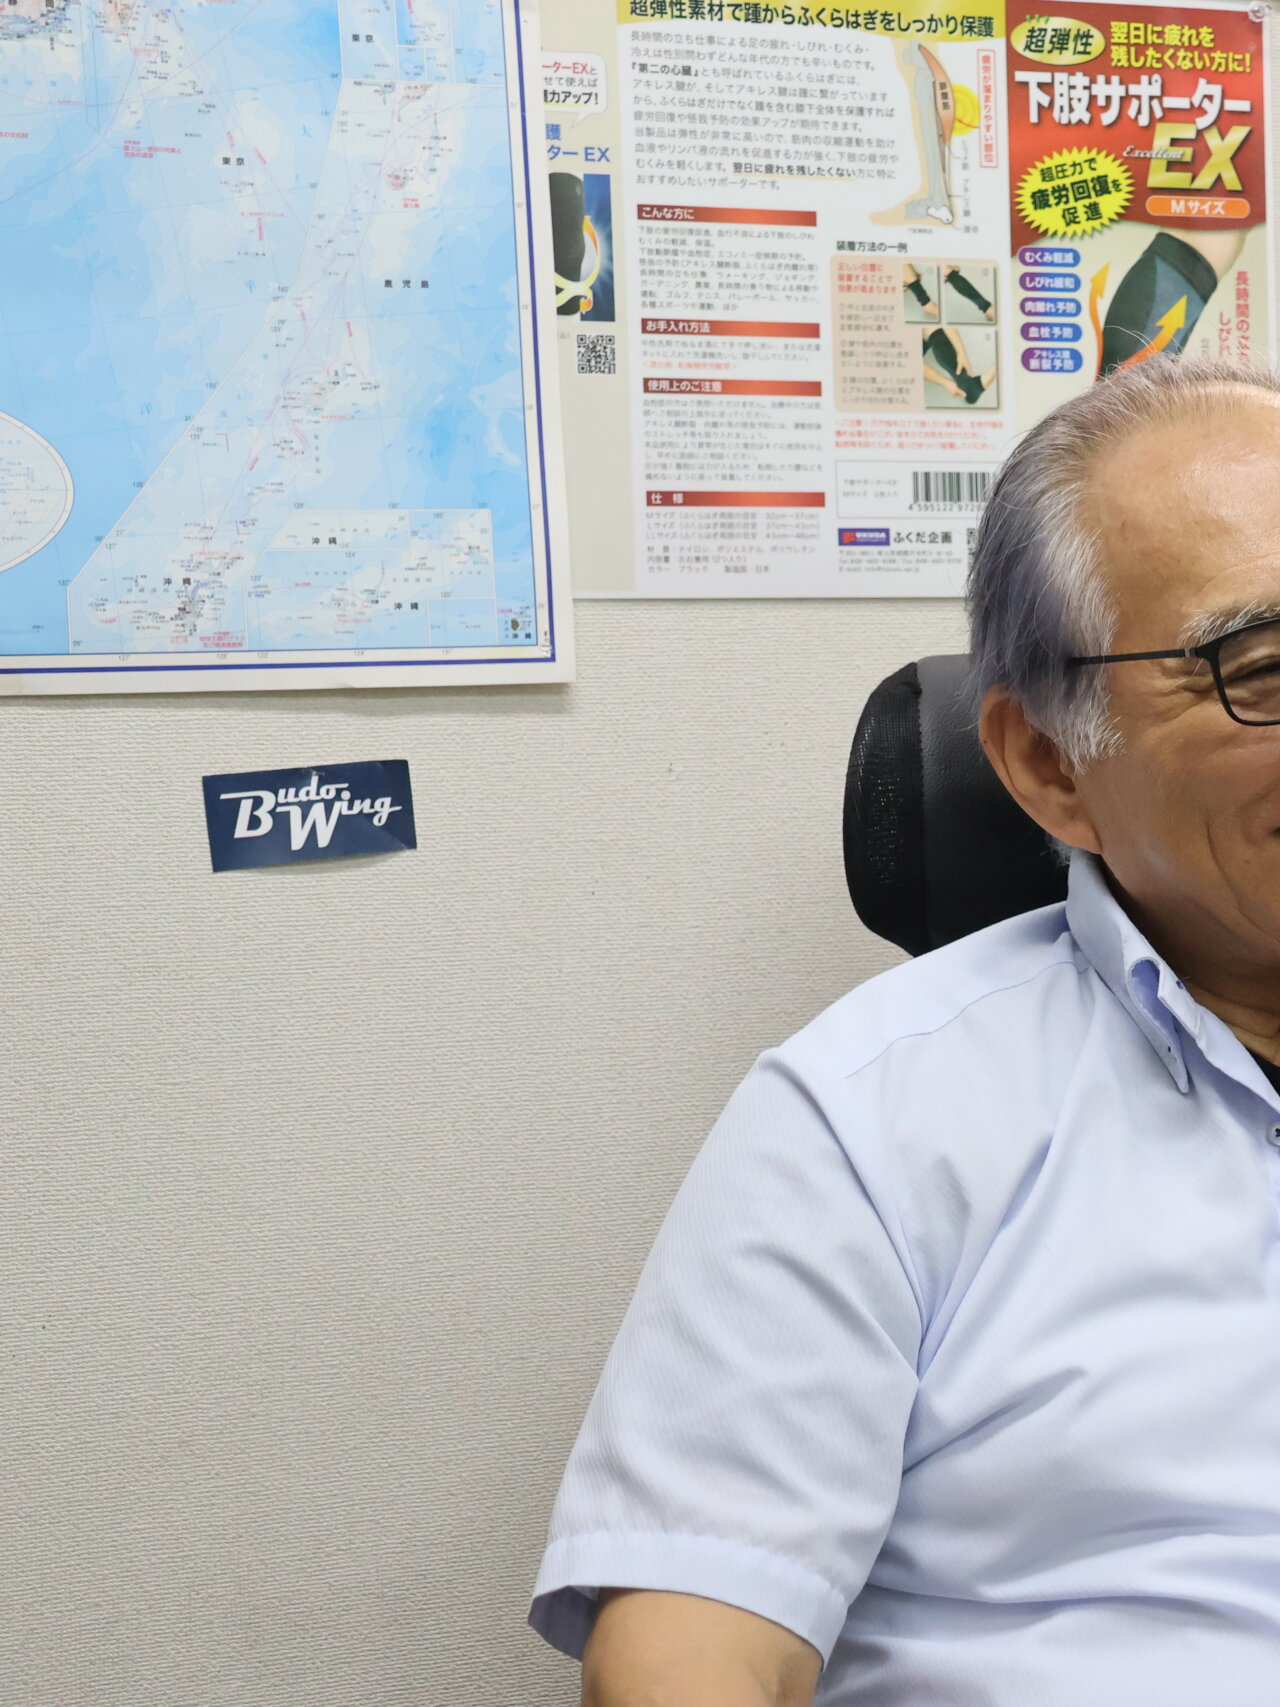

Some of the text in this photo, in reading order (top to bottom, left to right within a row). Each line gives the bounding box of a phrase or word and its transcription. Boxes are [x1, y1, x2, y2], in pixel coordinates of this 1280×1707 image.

[630, 0, 995, 38] 超弾性素材で踵からふくらはぎをしっかり保護
[351, 34, 374, 43] 東京
[1110, 21, 1215, 47] 翌日に疲れを
[1023, 26, 1094, 56] 超弾性
[1110, 45, 1251, 73] 残したくない方に!
[1014, 70, 1251, 130] 下肢サポーター
[584, 147, 611, 162] EX
[1122, 145, 1185, 160] Excellent
[1146, 122, 1252, 192] EX
[222, 157, 245, 166] 東京
[1039, 157, 1098, 183] 超圧力で
[1030, 174, 1122, 211] 疲労回復を
[642, 207, 695, 220] こんな方に
[1061, 201, 1103, 227] 促進
[1171, 200, 1225, 215] Mサイズ
[836, 240, 908, 253] 装着方法の一例
[1024, 252, 1074, 264] むくみ軽減
[384, 279, 429, 289] 鹿児島
[1025, 276, 1075, 289] しびれ緩和
[1024, 301, 1077, 313] 肉離れ予防
[646, 321, 711, 333] お手入れ方法
[1028, 326, 1074, 338] 血栓予防
[647, 380, 722, 393] 使用上のご注意
[312, 536, 337, 545] 沖縄
[893, 531, 952, 544] ふくだ企画
[163, 577, 191, 586] 沖縄
[394, 602, 419, 610] 沖縄
[219, 775, 349, 839] Budo
[276, 790, 402, 851] Wing
